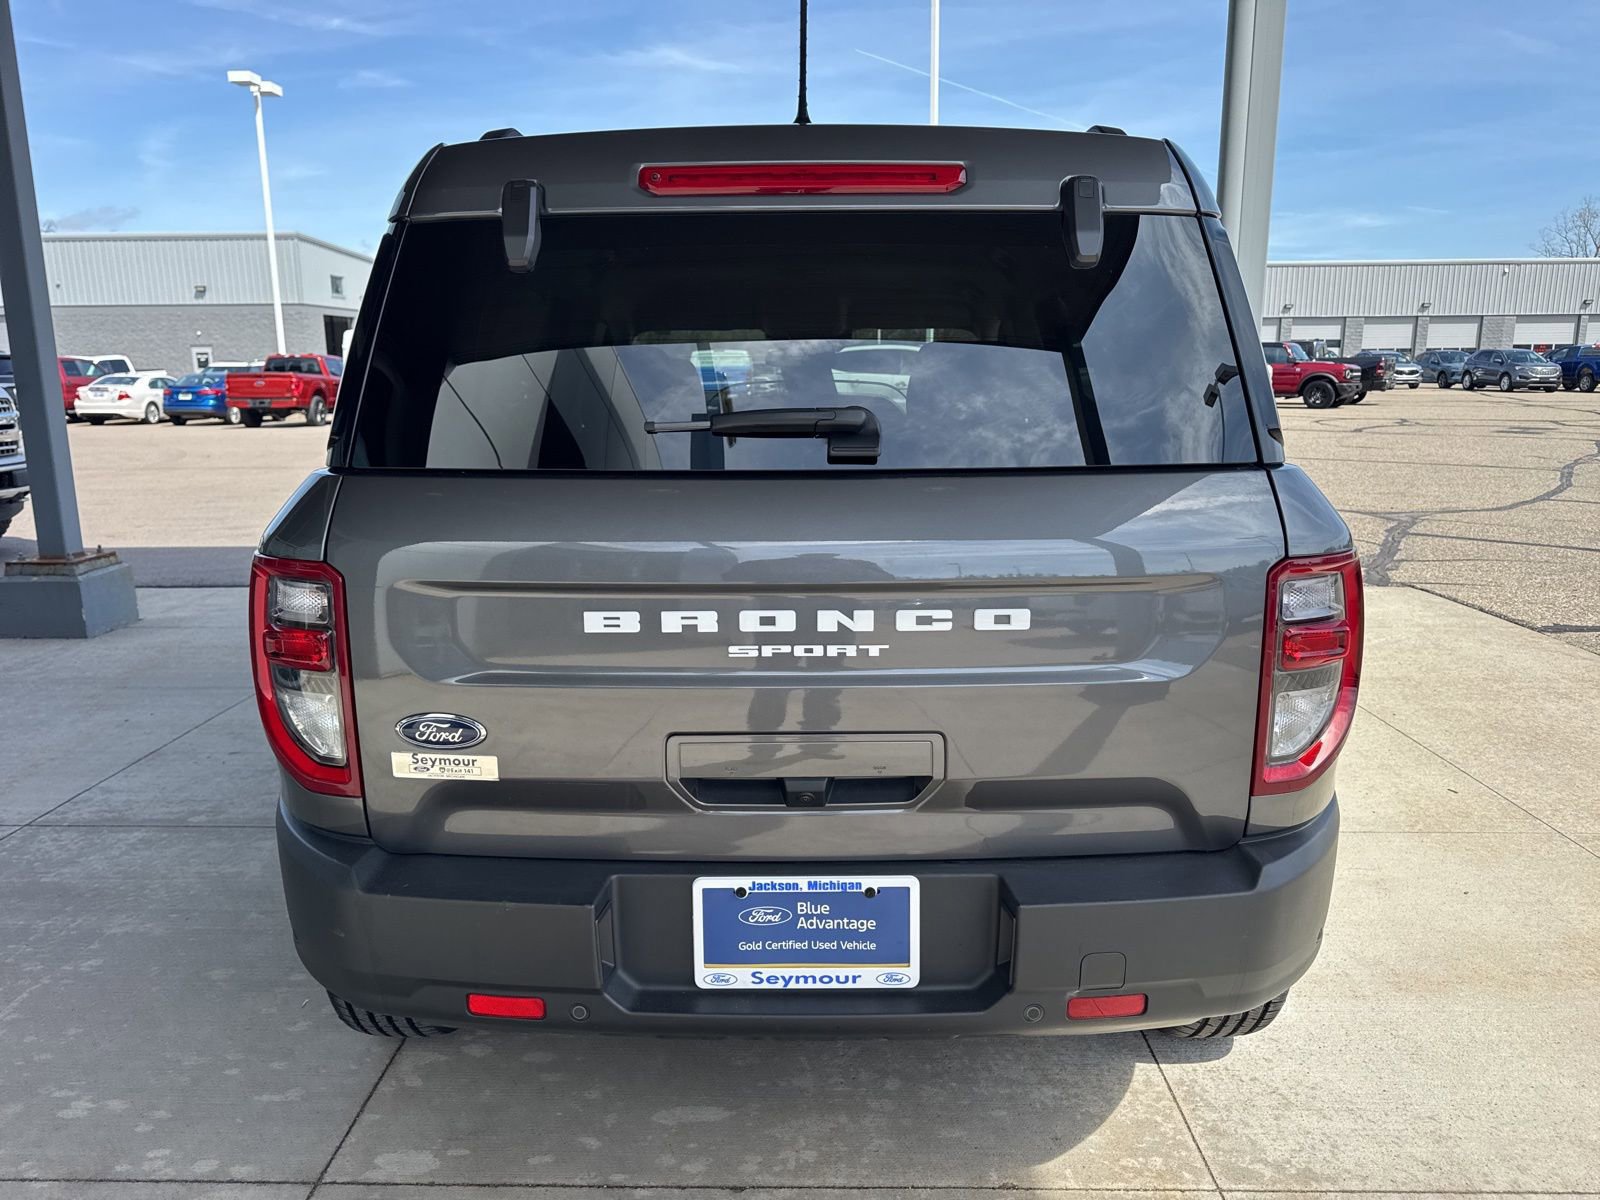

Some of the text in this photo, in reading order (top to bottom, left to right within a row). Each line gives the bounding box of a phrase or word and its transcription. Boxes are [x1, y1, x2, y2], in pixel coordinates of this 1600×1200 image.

[583, 608, 1031, 633] BRONCO
[727, 644, 890, 658] SPORT
[415, 721, 463, 742] Ford
[411, 753, 478, 768] Seymour
[748, 880, 862, 892] Jackson, Michigan
[797, 902, 830, 914] Blue
[748, 908, 782, 923] Ford
[797, 917, 877, 932] Advantage
[738, 940, 877, 951] Gold Certified Used Vehicle
[710, 974, 731, 984] Ford
[750, 971, 862, 987] Seymour
[883, 974, 904, 983] Ford
